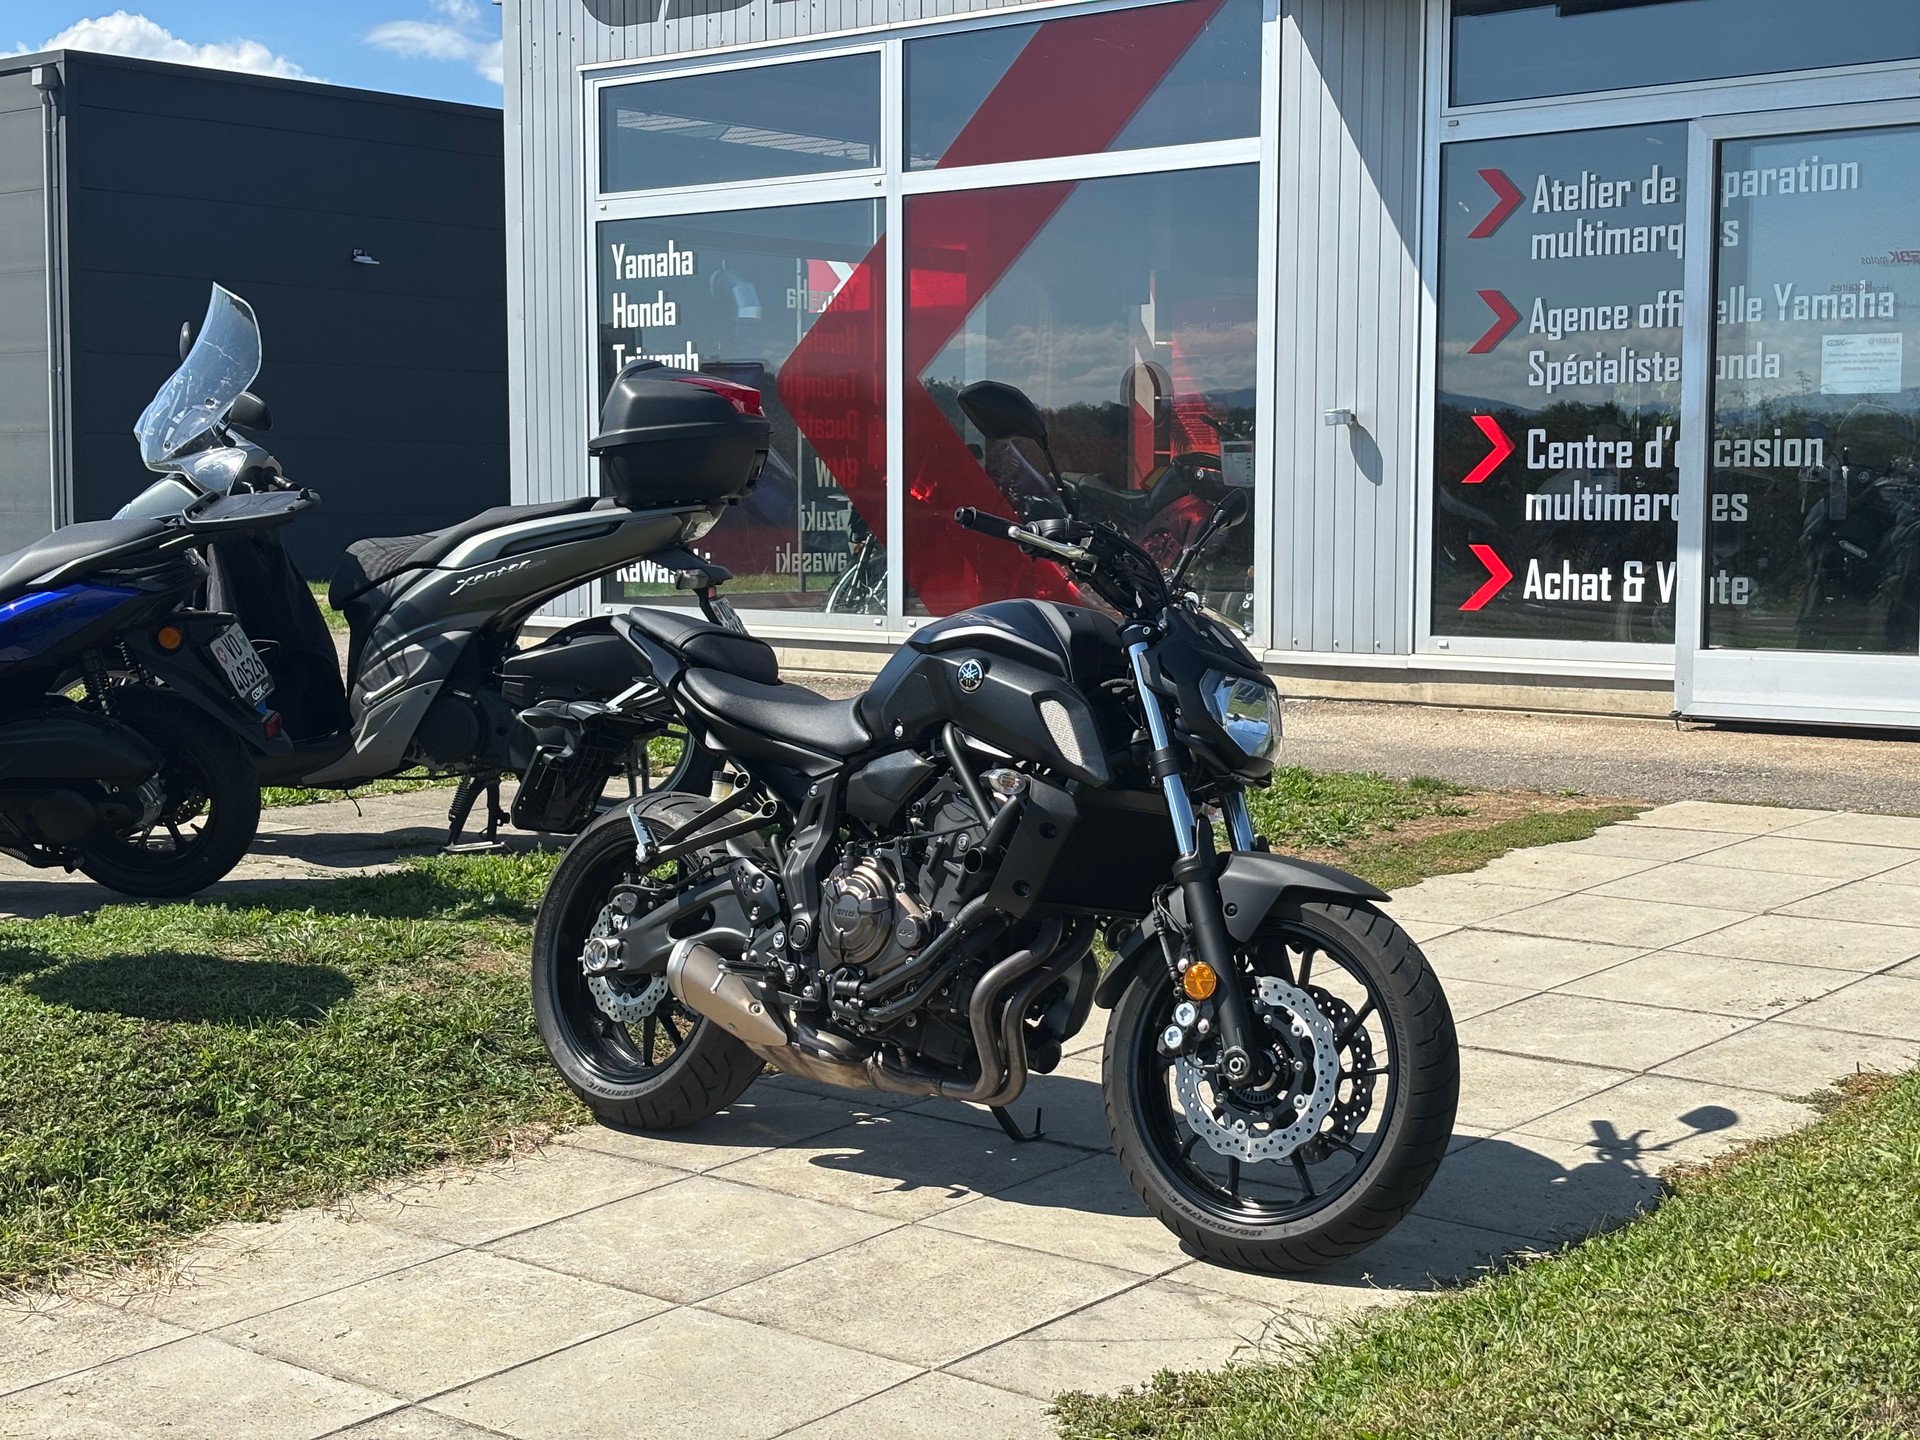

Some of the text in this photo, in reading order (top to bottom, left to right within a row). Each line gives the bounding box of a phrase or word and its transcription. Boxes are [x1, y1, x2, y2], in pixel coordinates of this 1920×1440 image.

[1532, 155, 1858, 213] Atelier de paration
[611, 239, 694, 280] Yamaha
[1531, 218, 1739, 260] multimarqs
[612, 290, 676, 329] Honda
[1529, 280, 1895, 341] Agence offielle Yamaha
[612, 341, 699, 374] Trimph
[1528, 341, 1780, 394] Spécialiste onda
[1527, 426, 1823, 470] Centre d'casion
[1525, 480, 1748, 522] multimares
[1522, 558, 1749, 605] Achat & Vte
[221, 633, 243, 661] VD
[230, 652, 265, 692] 40526
